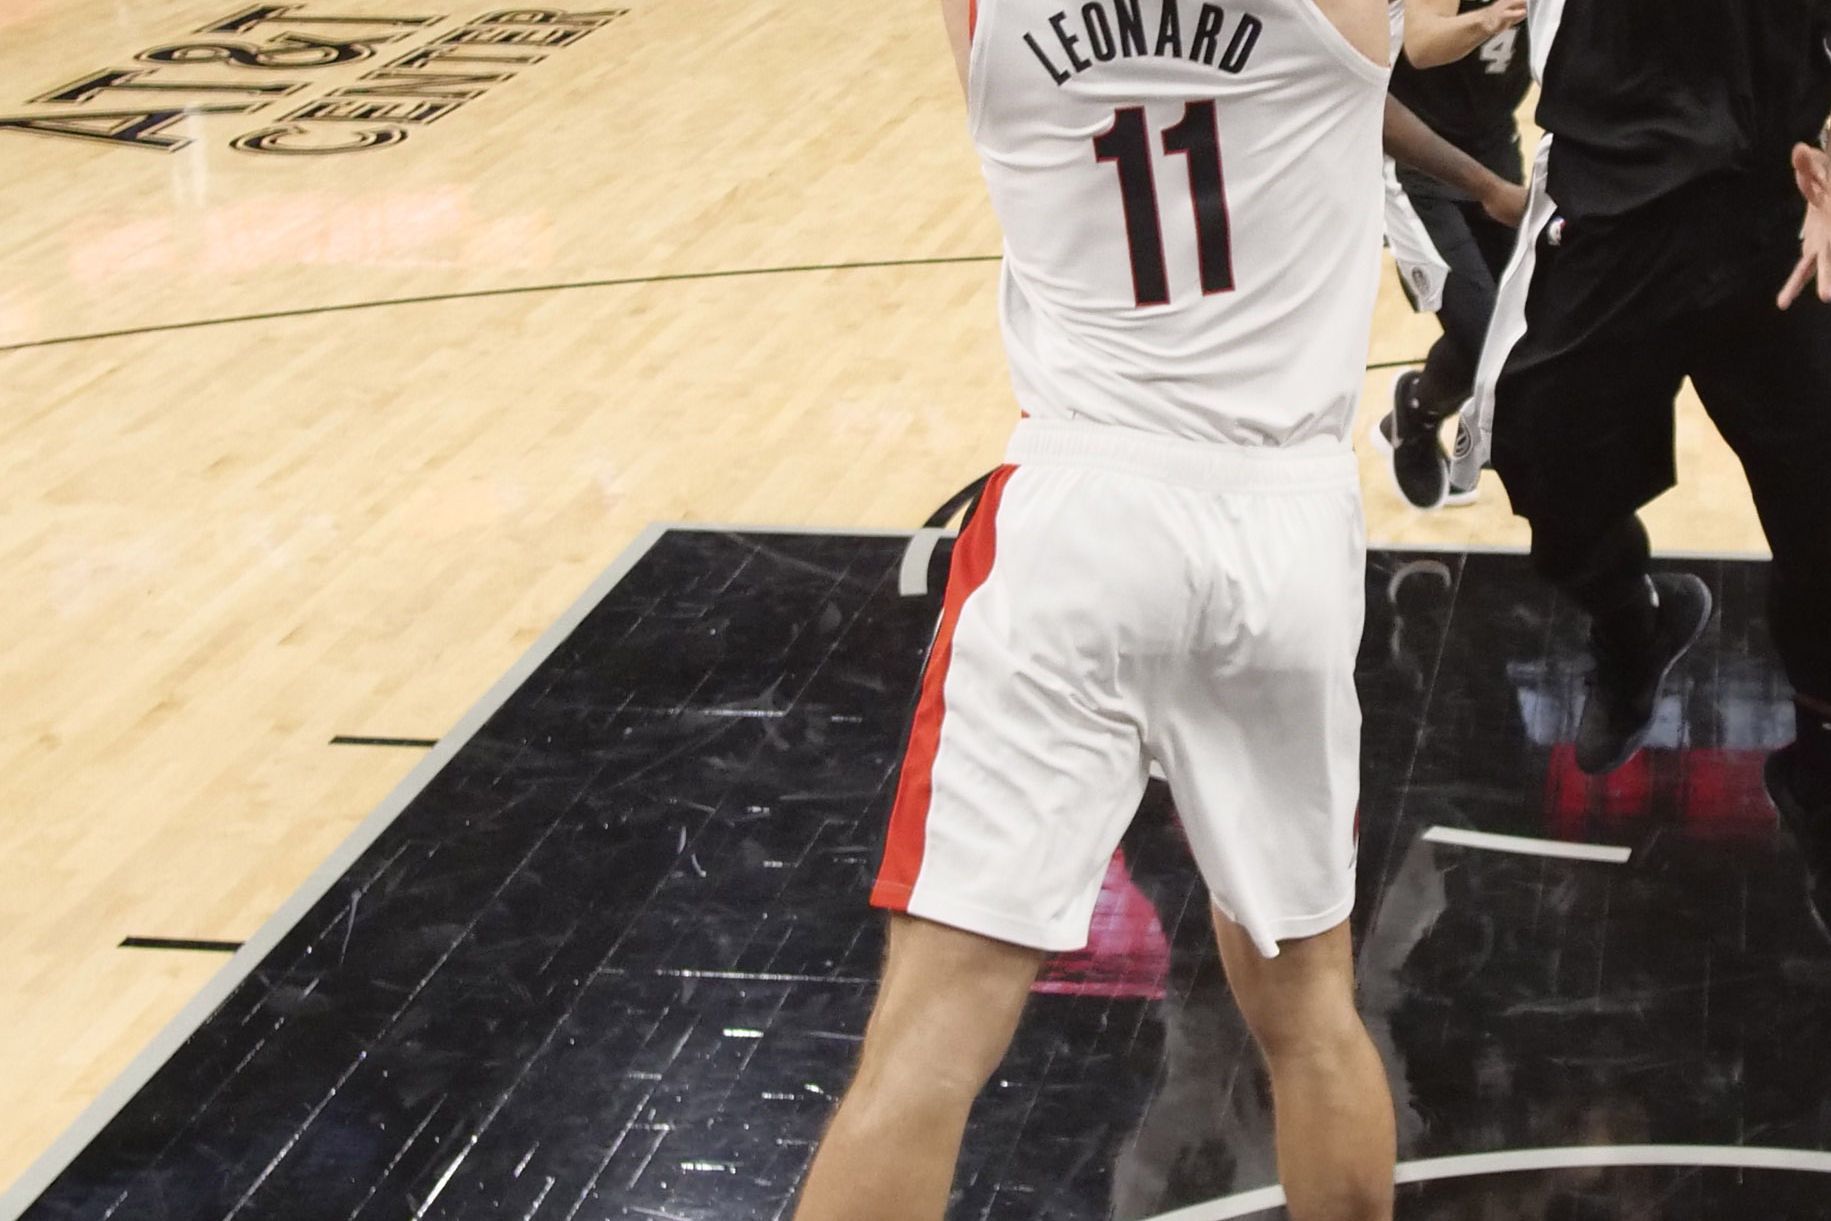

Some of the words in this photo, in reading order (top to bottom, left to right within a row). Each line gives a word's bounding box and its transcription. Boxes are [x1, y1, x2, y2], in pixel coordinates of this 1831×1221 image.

[0, 3, 450, 153] AT&T
[228, 7, 633, 156] CENTER
[1479, 26, 1520, 75] 4
[1091, 98, 1237, 308] 11
